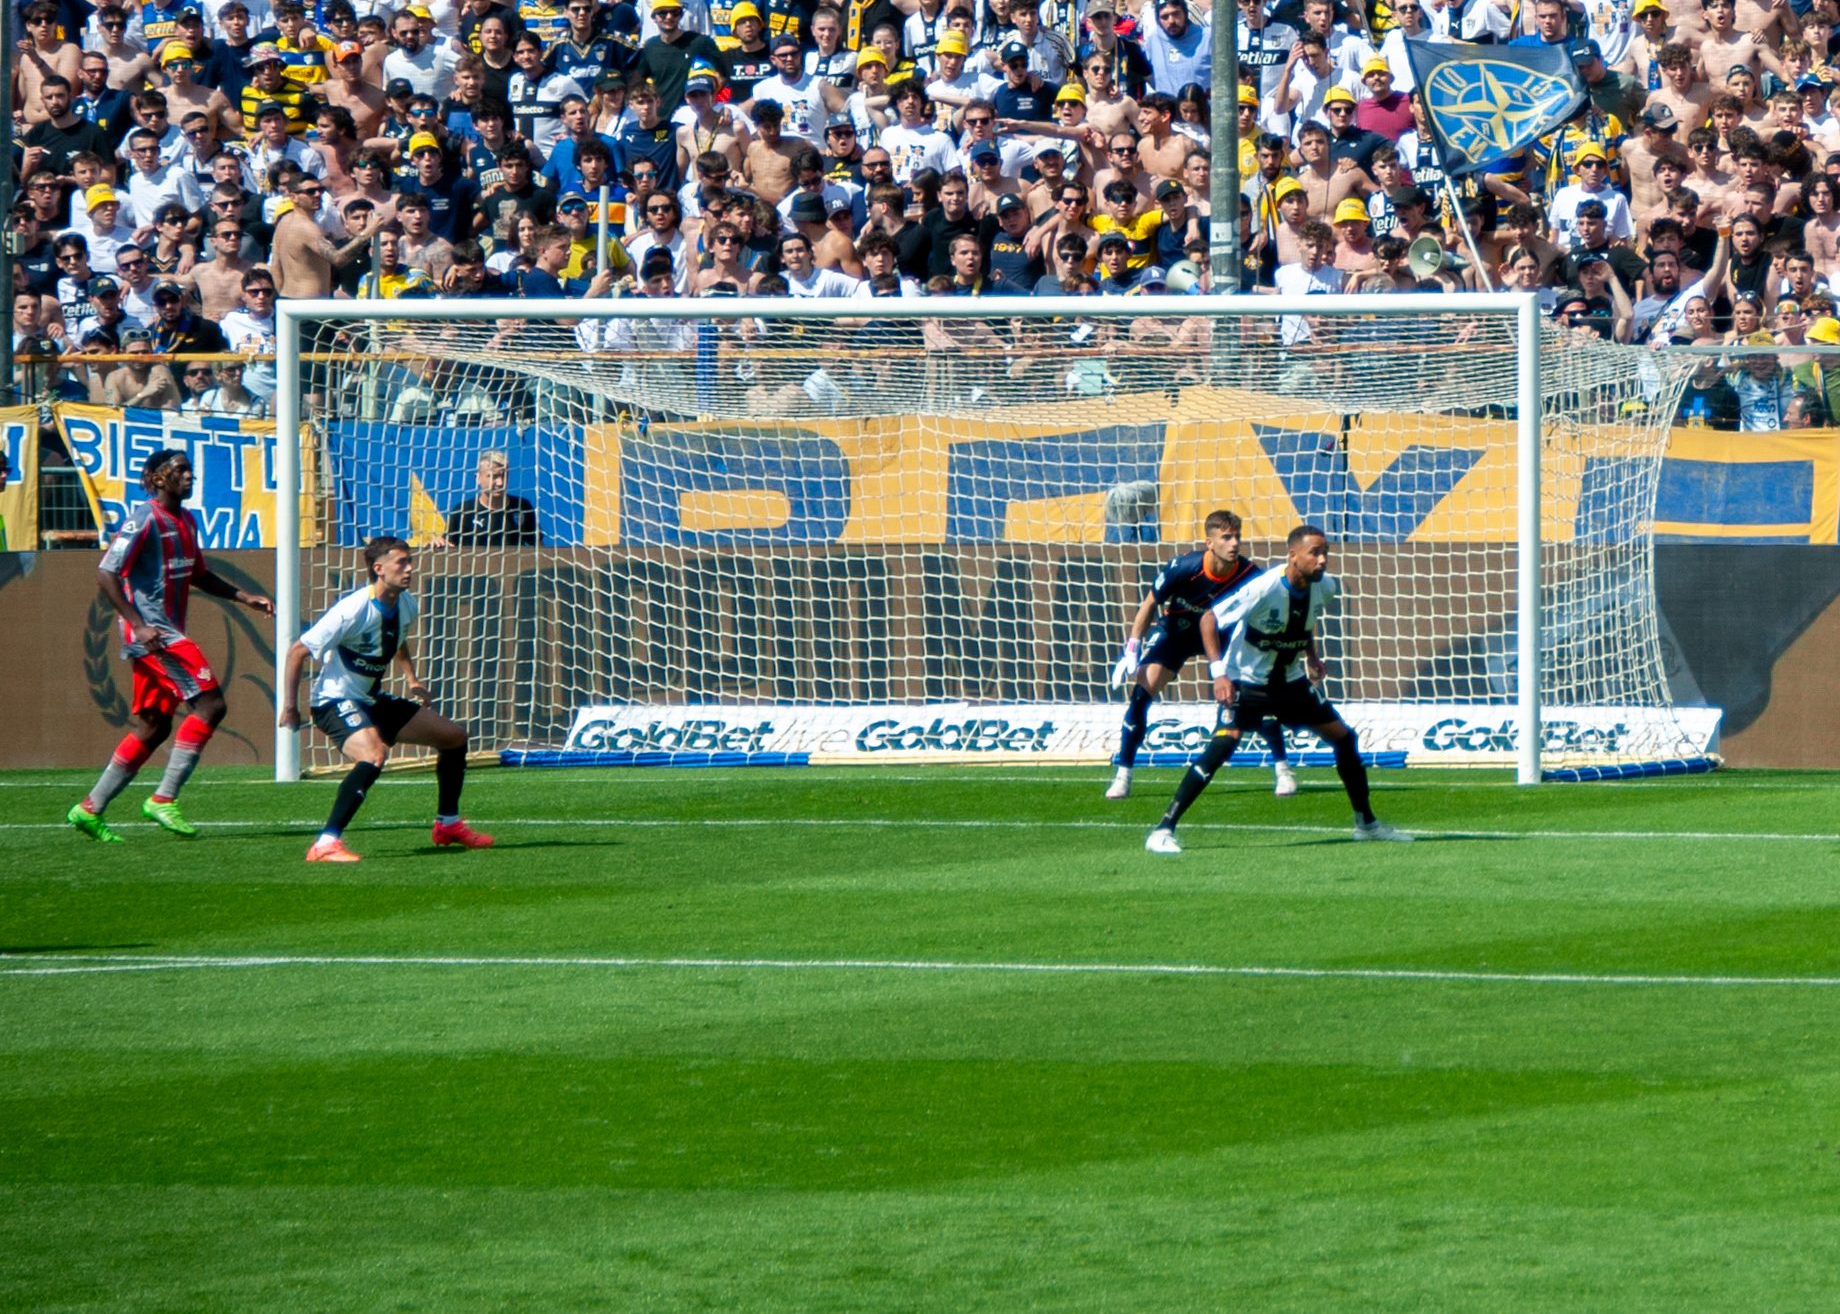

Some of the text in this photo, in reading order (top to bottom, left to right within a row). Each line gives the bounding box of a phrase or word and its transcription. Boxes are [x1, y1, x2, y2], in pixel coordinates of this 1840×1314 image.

[60, 415, 305, 492] BIETT
[573, 718, 776, 753] GoldBet
[855, 718, 1060, 753] GoldBet
